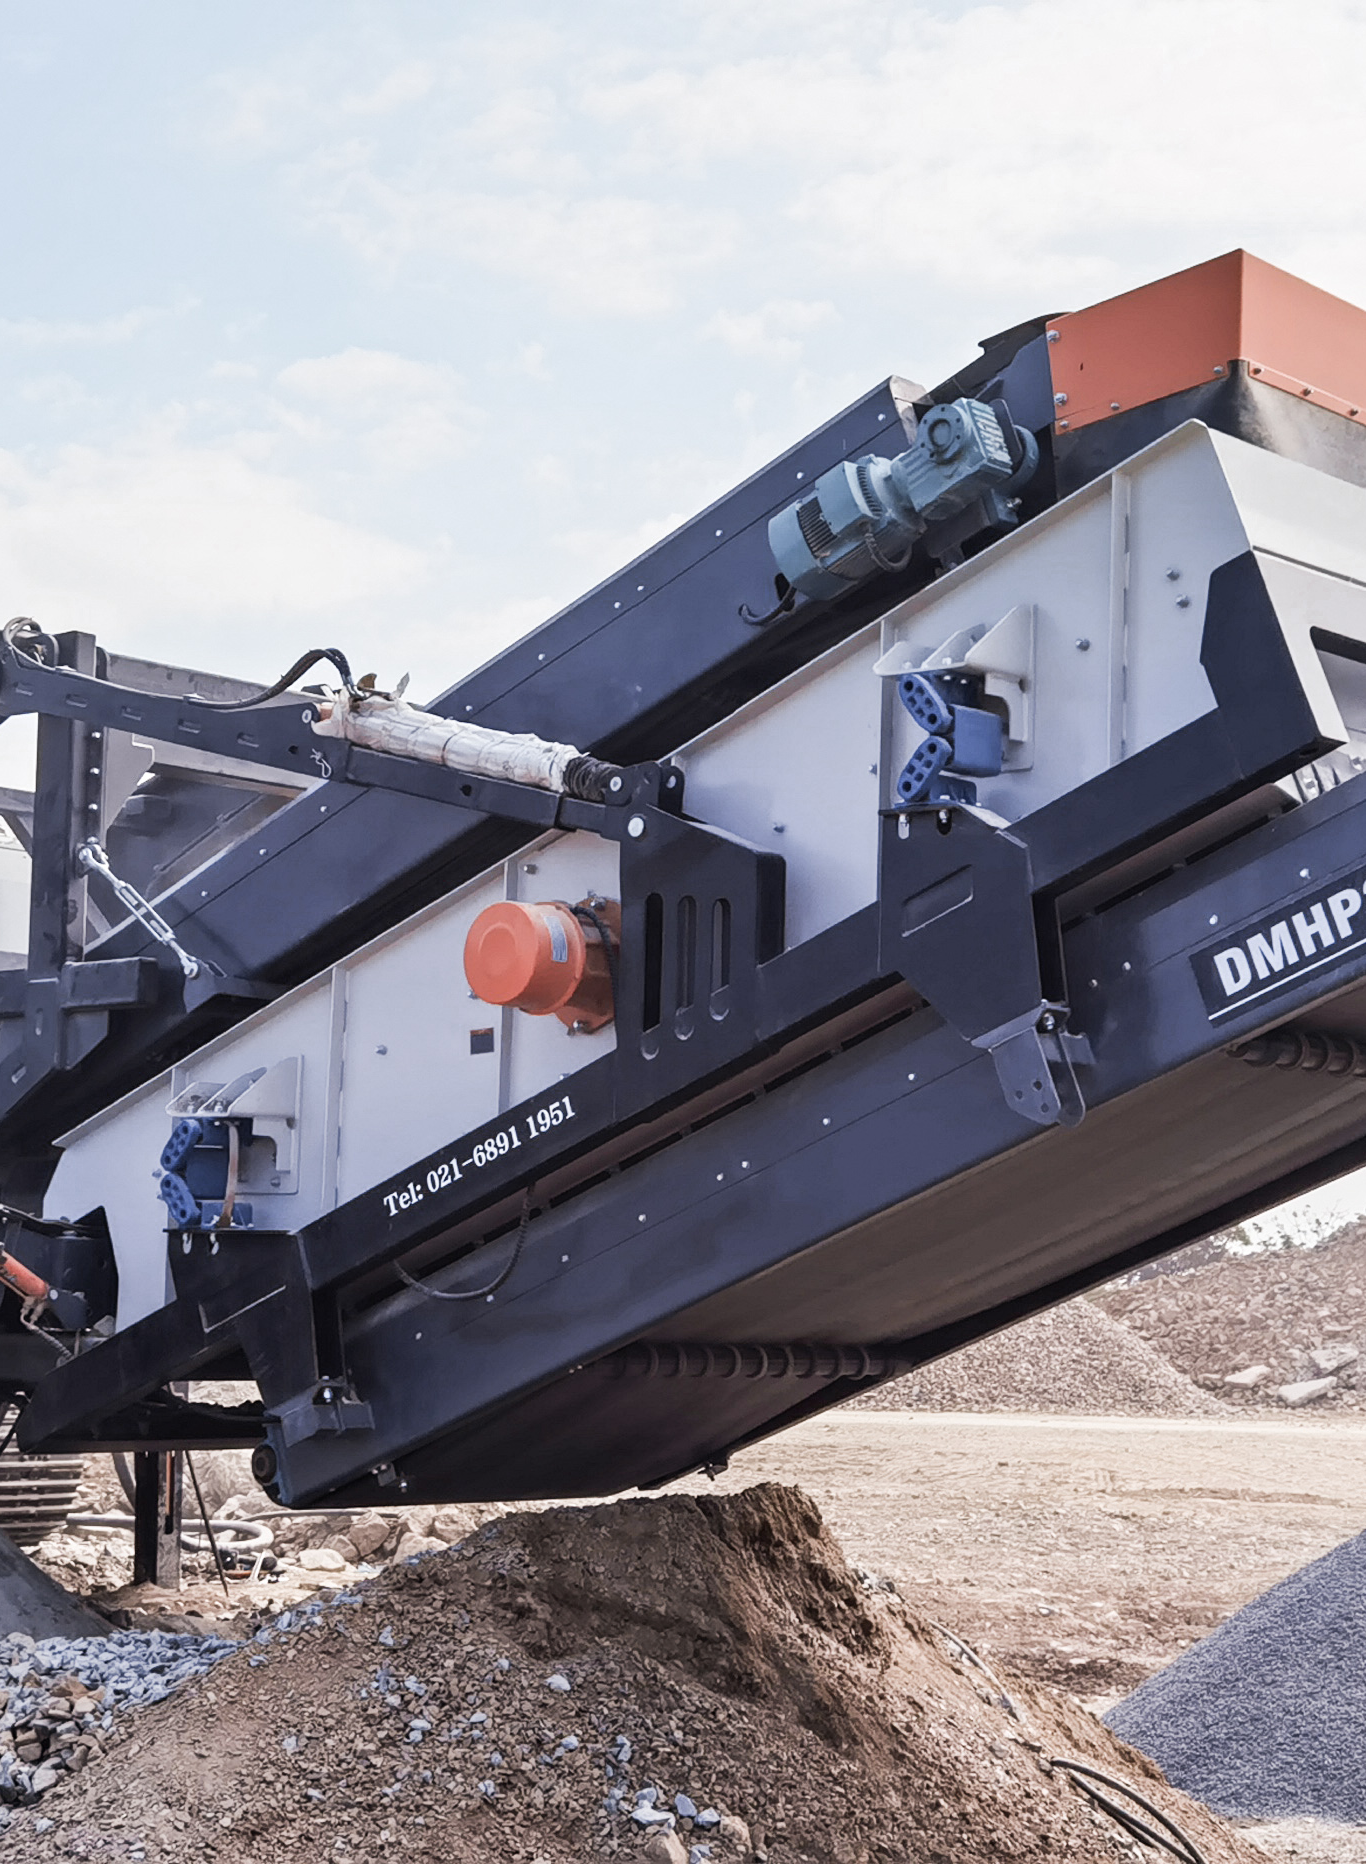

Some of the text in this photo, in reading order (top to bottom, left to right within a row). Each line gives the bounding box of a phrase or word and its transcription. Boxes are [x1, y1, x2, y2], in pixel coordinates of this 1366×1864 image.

[383, 1096, 576, 1216] Tel: 021-6891 1951
